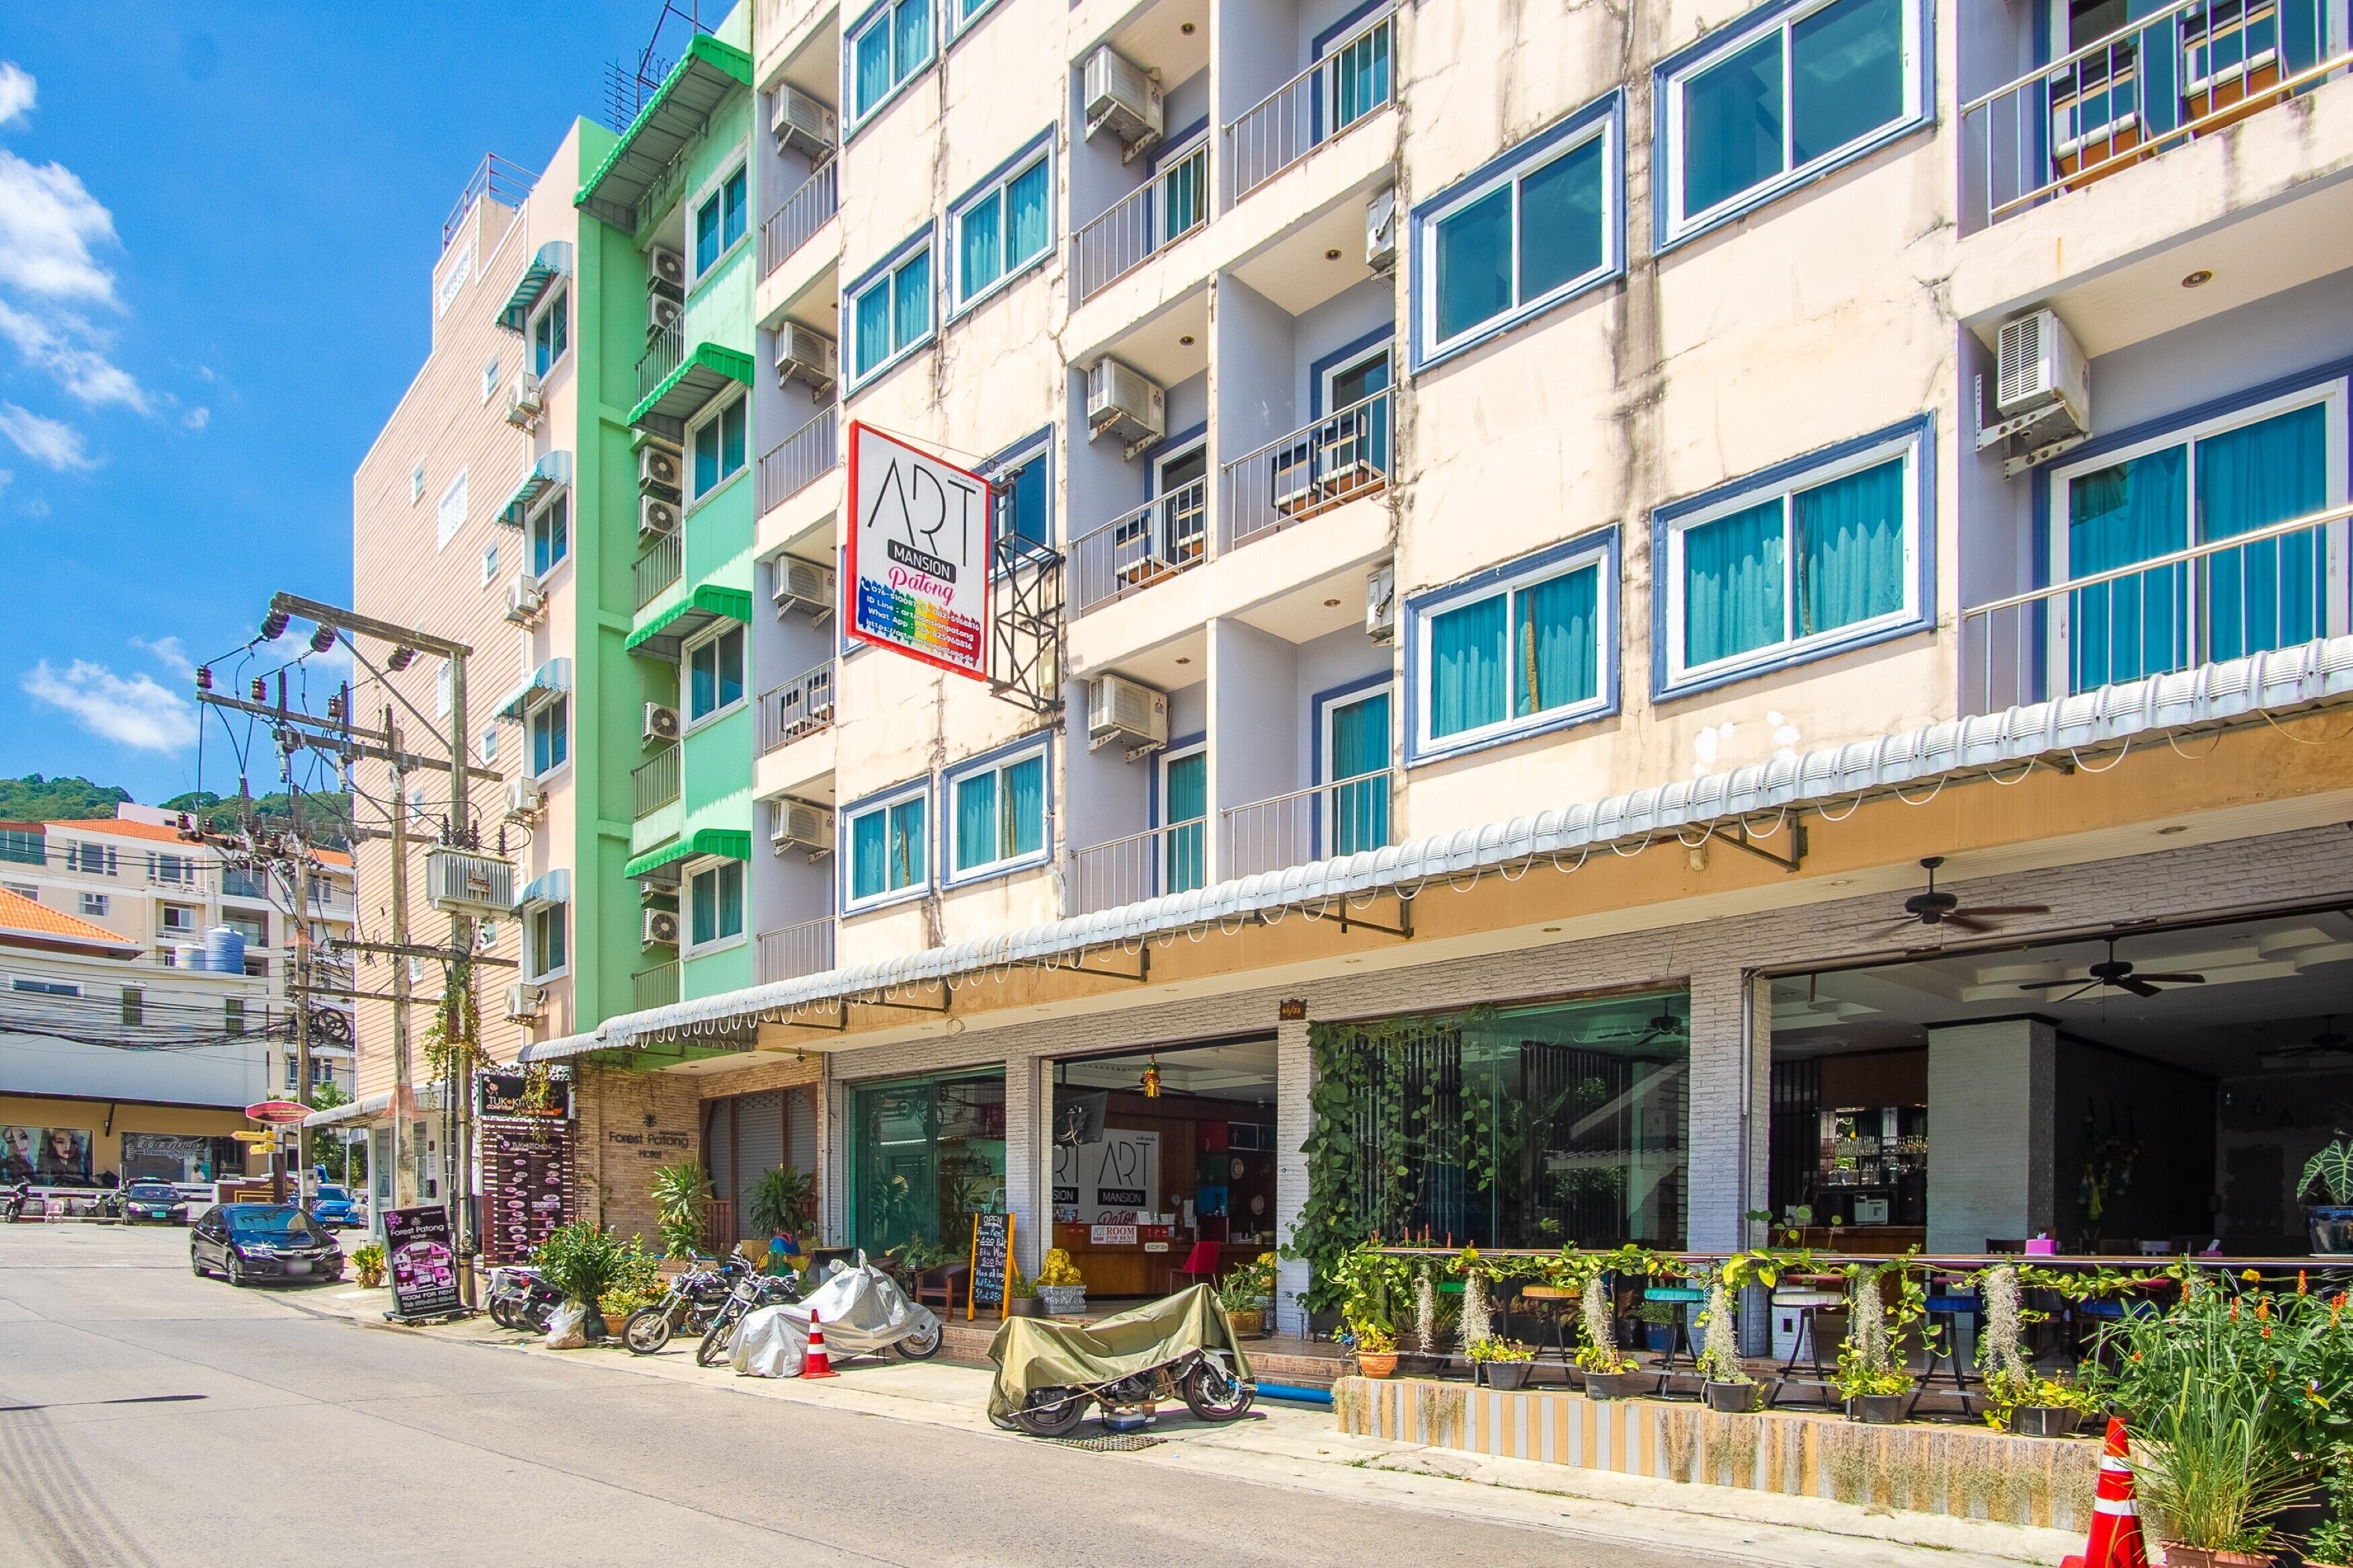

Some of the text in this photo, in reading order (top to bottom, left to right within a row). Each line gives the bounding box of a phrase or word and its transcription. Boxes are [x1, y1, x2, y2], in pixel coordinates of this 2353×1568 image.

[867, 457, 976, 567] ART
[893, 544, 950, 579] MANSION
[889, 567, 955, 606] Patong
[866, 595, 875, 604] ID
[877, 600, 894, 611] Line
[901, 609, 974, 642] artmansionpatong
[867, 607, 890, 621] What
[892, 616, 908, 628] App
[488, 1097, 508, 1106] TUK
[608, 1131, 643, 1144] Forest
[647, 1134, 689, 1149] Patong
[639, 1150, 662, 1158] Hotel
[1099, 1141, 1150, 1186] ART
[1103, 1192, 1141, 1202] MANSION
[984, 1215, 1002, 1225] OPEN
[1097, 1209, 1138, 1225] Paton
[390, 1224, 444, 1237] Forest Patong
[1106, 1227, 1135, 1235] ROOM
